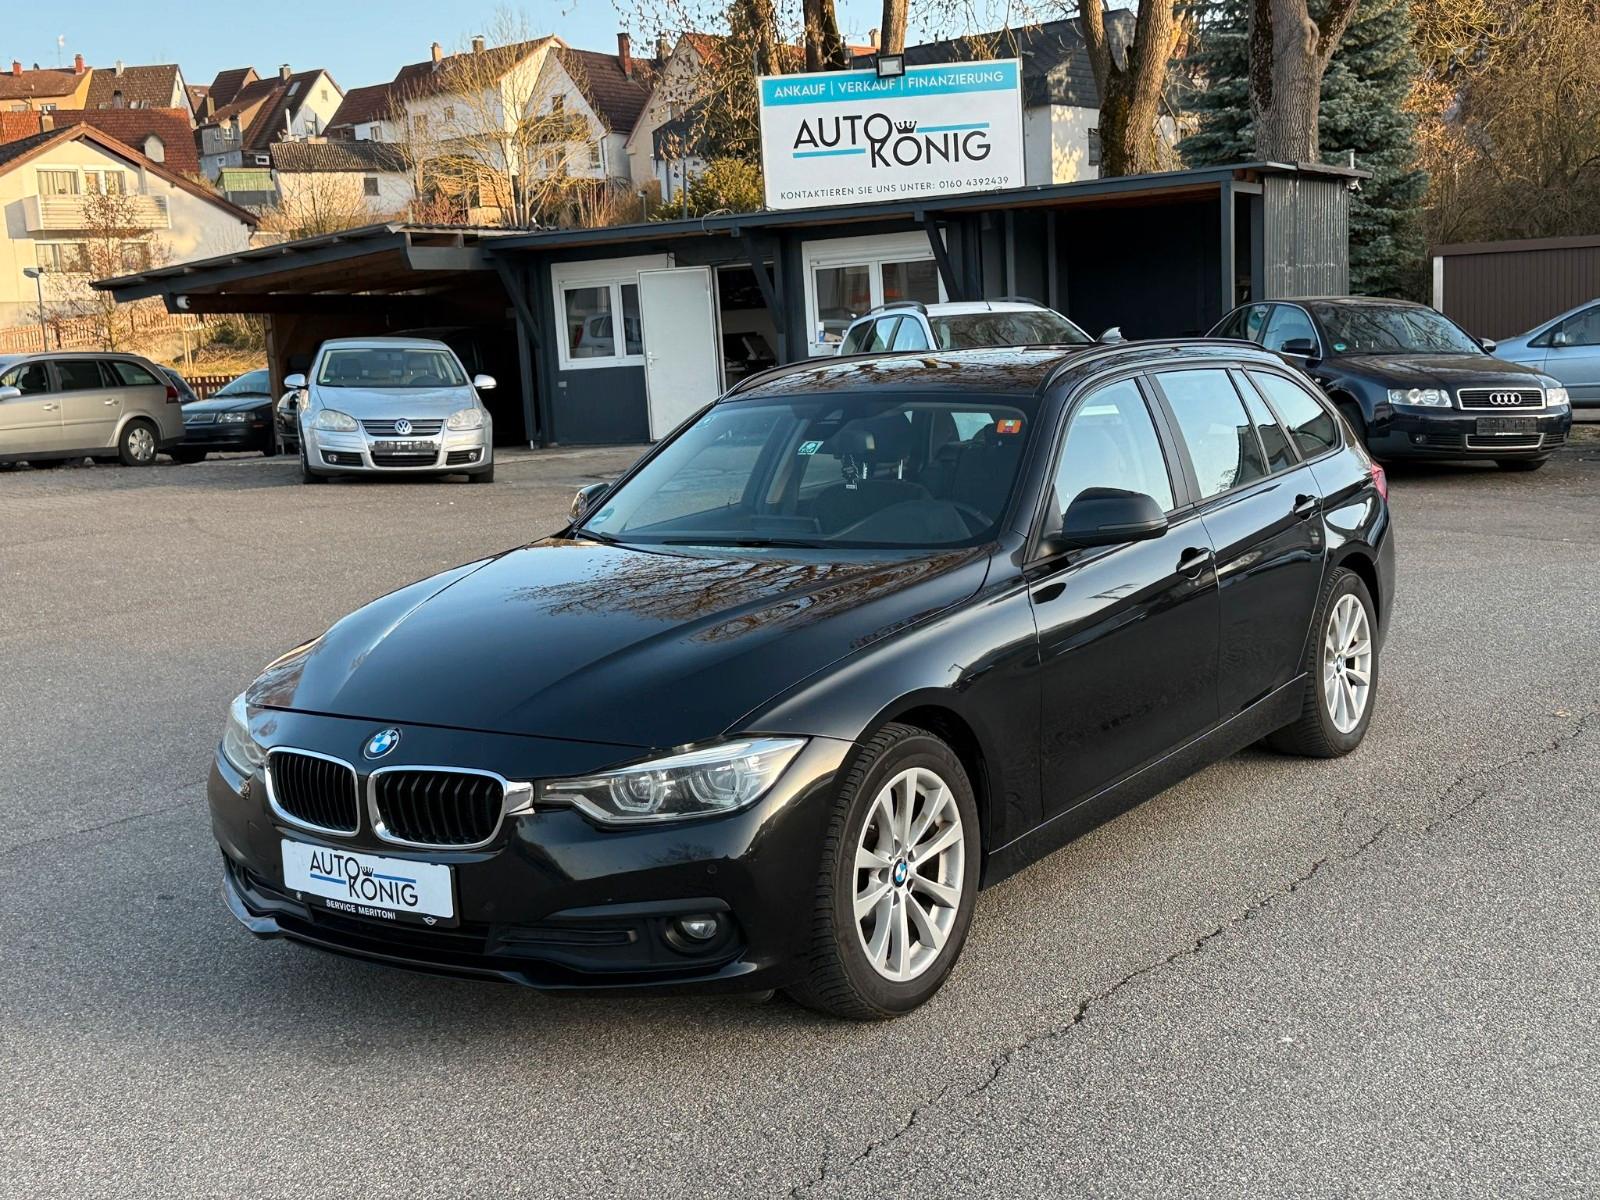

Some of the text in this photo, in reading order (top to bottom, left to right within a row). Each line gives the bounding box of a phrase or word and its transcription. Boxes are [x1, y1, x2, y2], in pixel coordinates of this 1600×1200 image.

[774, 71, 1004, 97] ANKAUF VERKAUF FINANZIERUNG
[793, 113, 893, 149] AUTO
[780, 176, 1009, 200] KONTAKTIEREN SIE UNS UNTER: 0160 4392439
[309, 850, 360, 879] AUTO
[326, 899, 396, 920] SERVICE MERITONI
